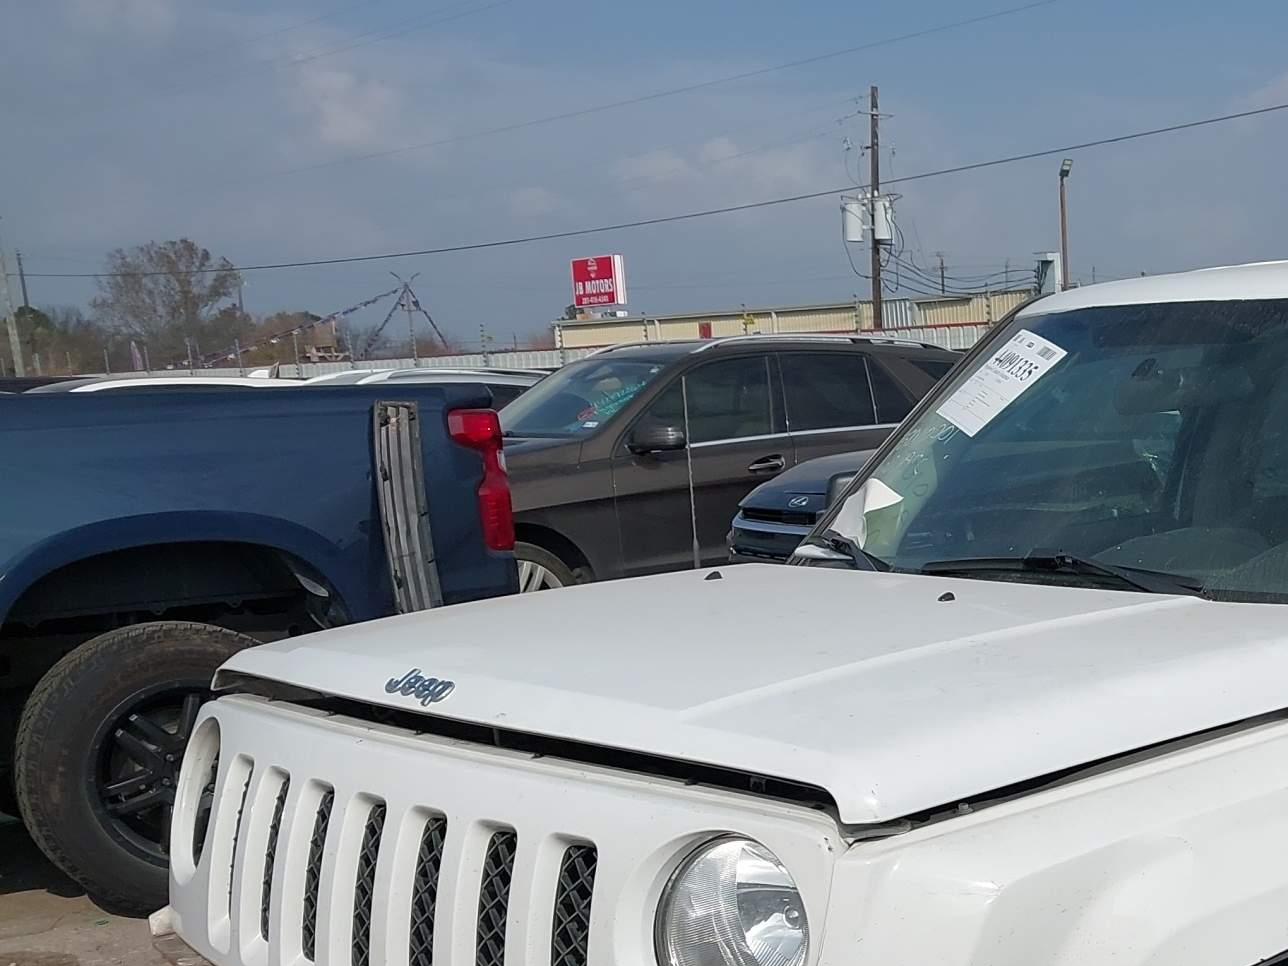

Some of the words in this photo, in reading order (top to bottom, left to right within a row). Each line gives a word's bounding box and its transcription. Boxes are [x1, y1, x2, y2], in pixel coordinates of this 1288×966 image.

[585, 278, 613, 294] MOTORS
[992, 348, 1039, 381] 44091335
[385, 668, 455, 707] Jeep
